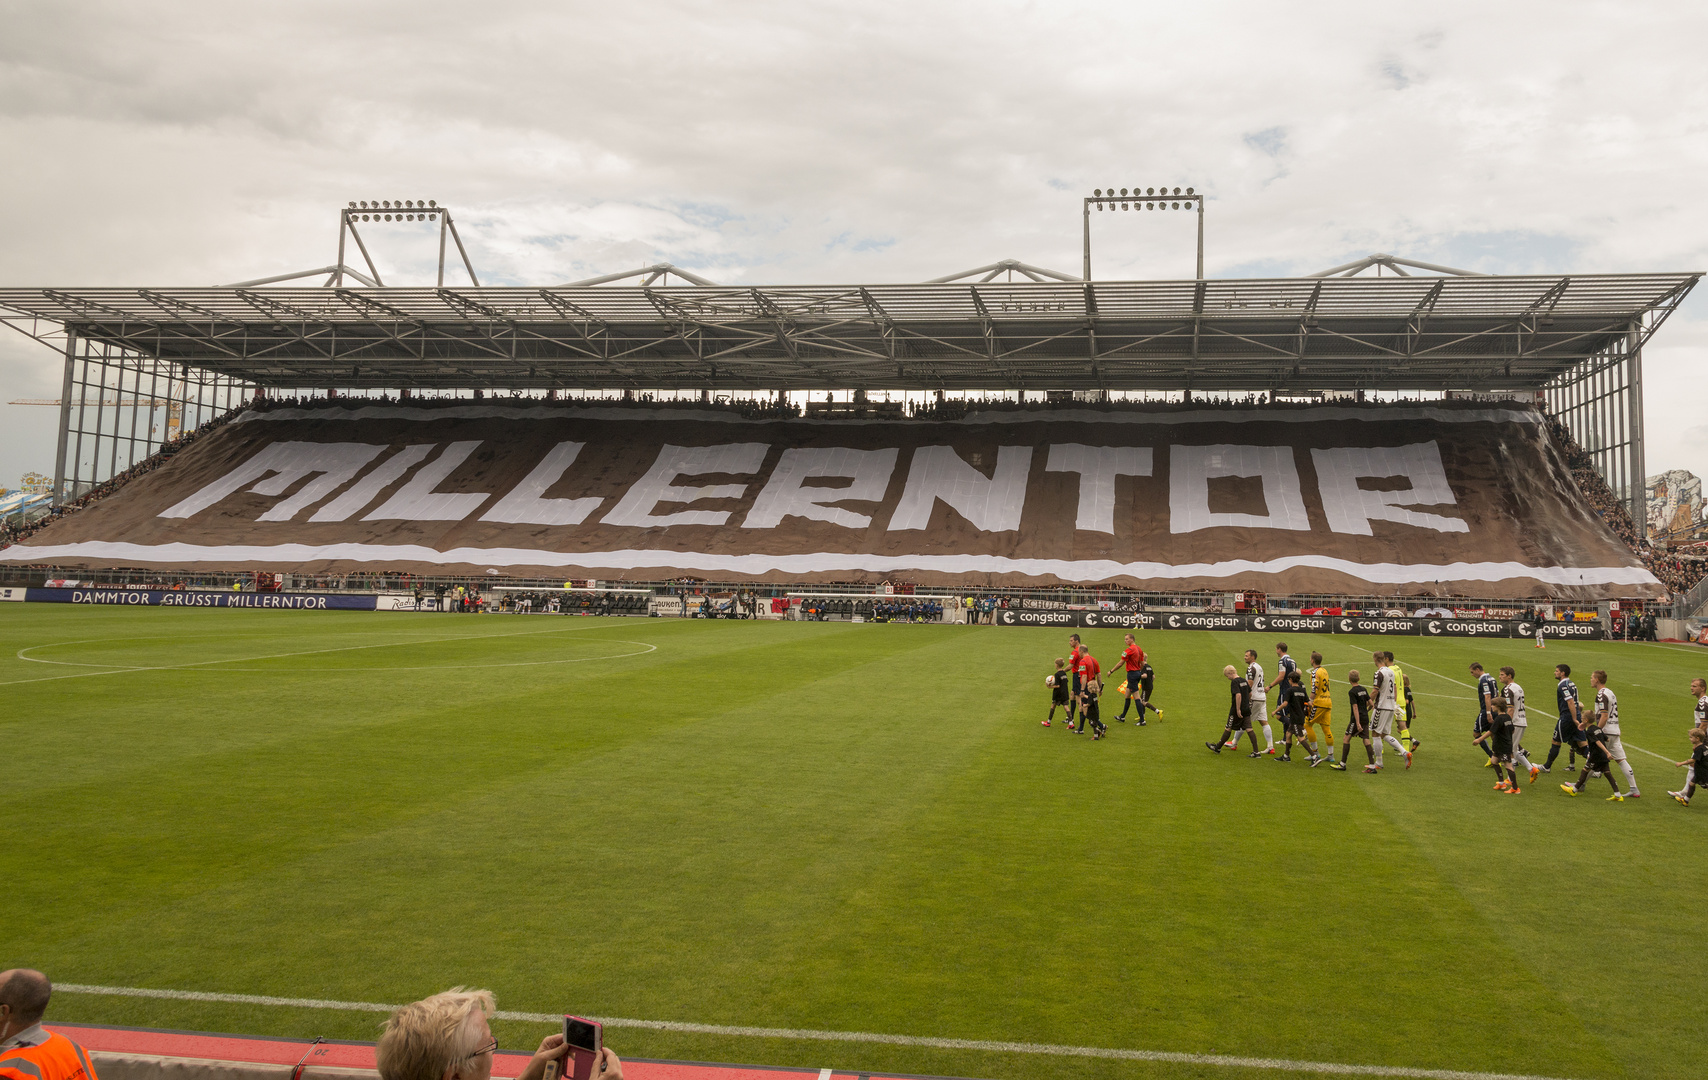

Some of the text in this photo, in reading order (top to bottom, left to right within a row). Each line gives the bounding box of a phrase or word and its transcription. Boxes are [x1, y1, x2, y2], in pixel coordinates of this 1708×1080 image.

[156, 439, 1469, 536] MILLERNTOR
[72, 591, 327, 609] DAMMTOR GRÜSST MILLERNTOR
[1020, 612, 1071, 624] congstar
[1102, 613, 1154, 626] congsar
[1186, 616, 1239, 628] congstar
[1271, 618, 1326, 630] congstar
[1358, 620, 1413, 632] congstar
[1446, 622, 1503, 635] congstar
[1542, 624, 1594, 637] ongstar
[1389, 679, 1394, 694] 3
